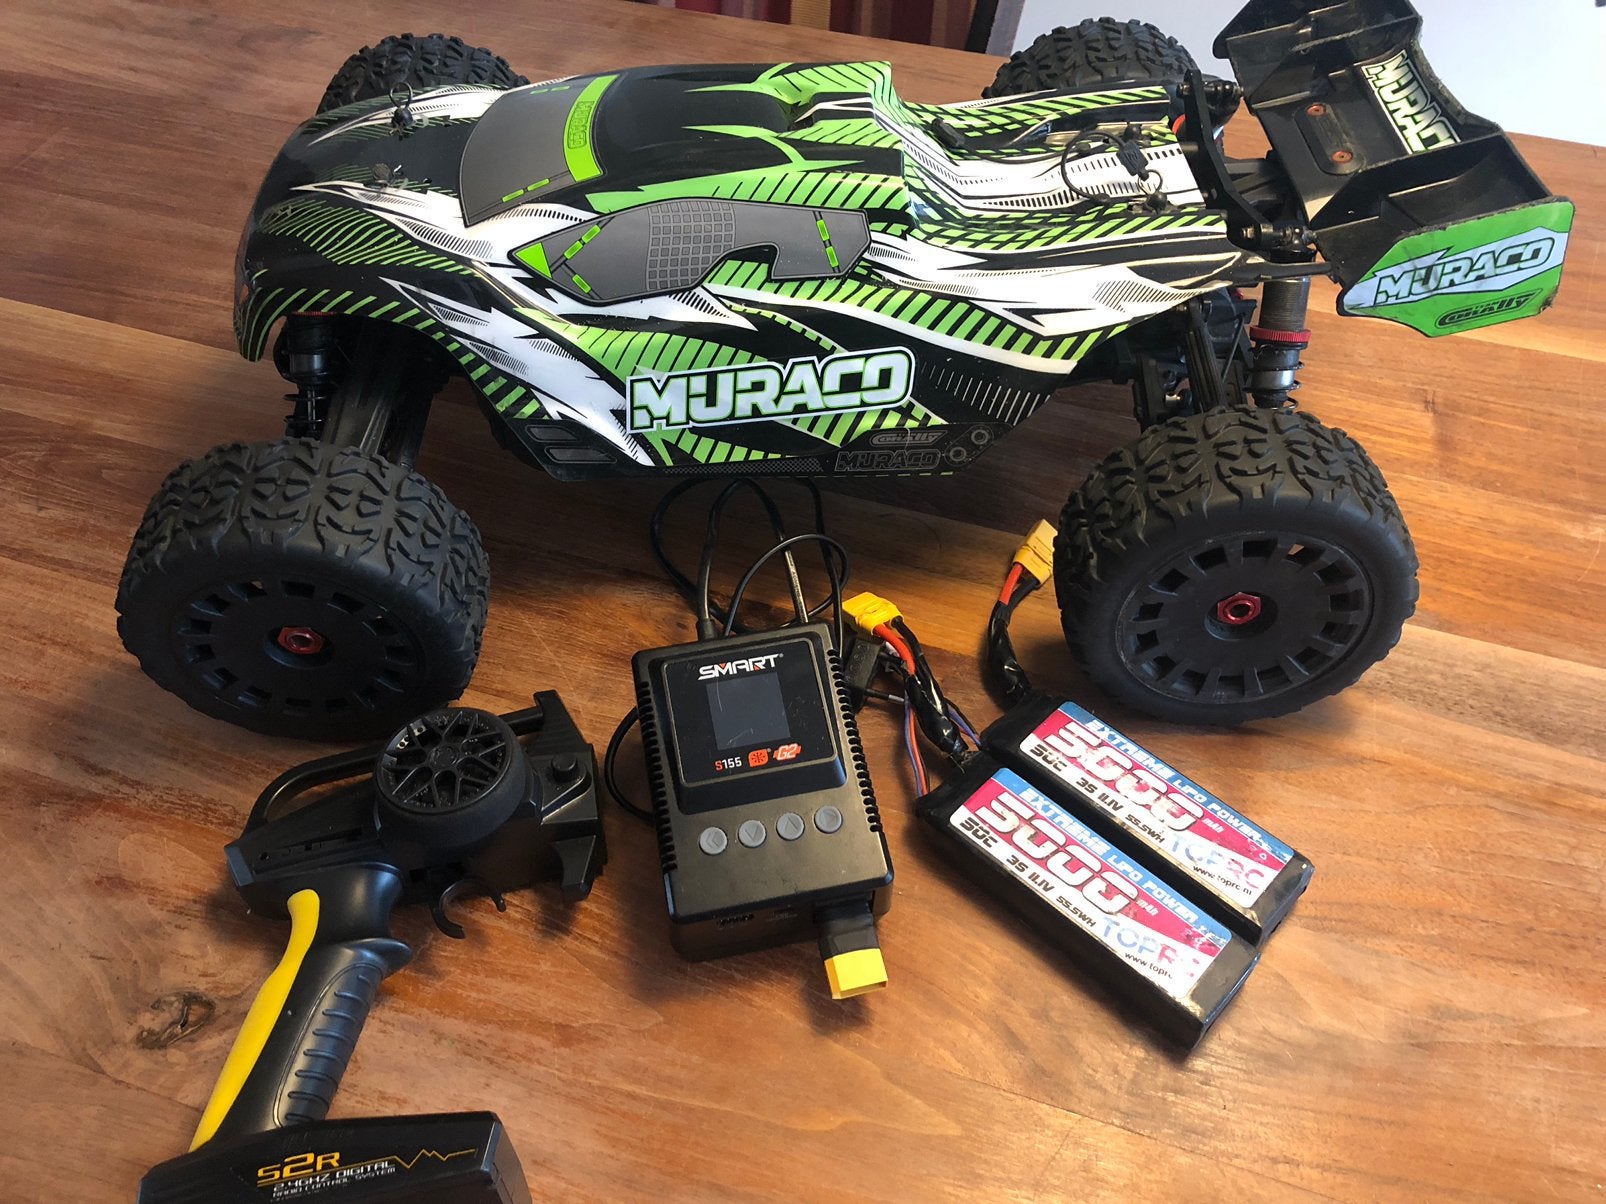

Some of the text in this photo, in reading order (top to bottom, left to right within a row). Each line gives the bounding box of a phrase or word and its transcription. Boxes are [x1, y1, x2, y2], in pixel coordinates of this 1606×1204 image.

[1362, 51, 1460, 154] MURAC
[1375, 237, 1554, 305] MURACO
[628, 349, 912, 430] MURACO
[835, 449, 941, 472] MURACO
[698, 654, 779, 680] SMART
[715, 757, 742, 771] S155
[775, 743, 800, 761] G2
[1030, 744, 1067, 772] 50C
[1076, 777, 1098, 794] 3S
[1098, 793, 1124, 812] 11.1V
[1043, 721, 1204, 831] 5000
[1086, 719, 1262, 841] EXTREME LIPO POWER
[959, 816, 998, 848] 50C
[1006, 855, 1028, 873] 3S
[1028, 872, 1055, 893] 11.1V
[974, 791, 1138, 915] 5000
[1018, 787, 1198, 923] EXTREME LIPO POWER
[1103, 917, 1199, 977] TOPR
[257, 1152, 340, 1179] S2R
[273, 1160, 396, 1192] 2.4GHZ DIGITAL
[304, 1178, 348, 1192] CONTROL
[355, 1167, 396, 1180] SYSTEM
